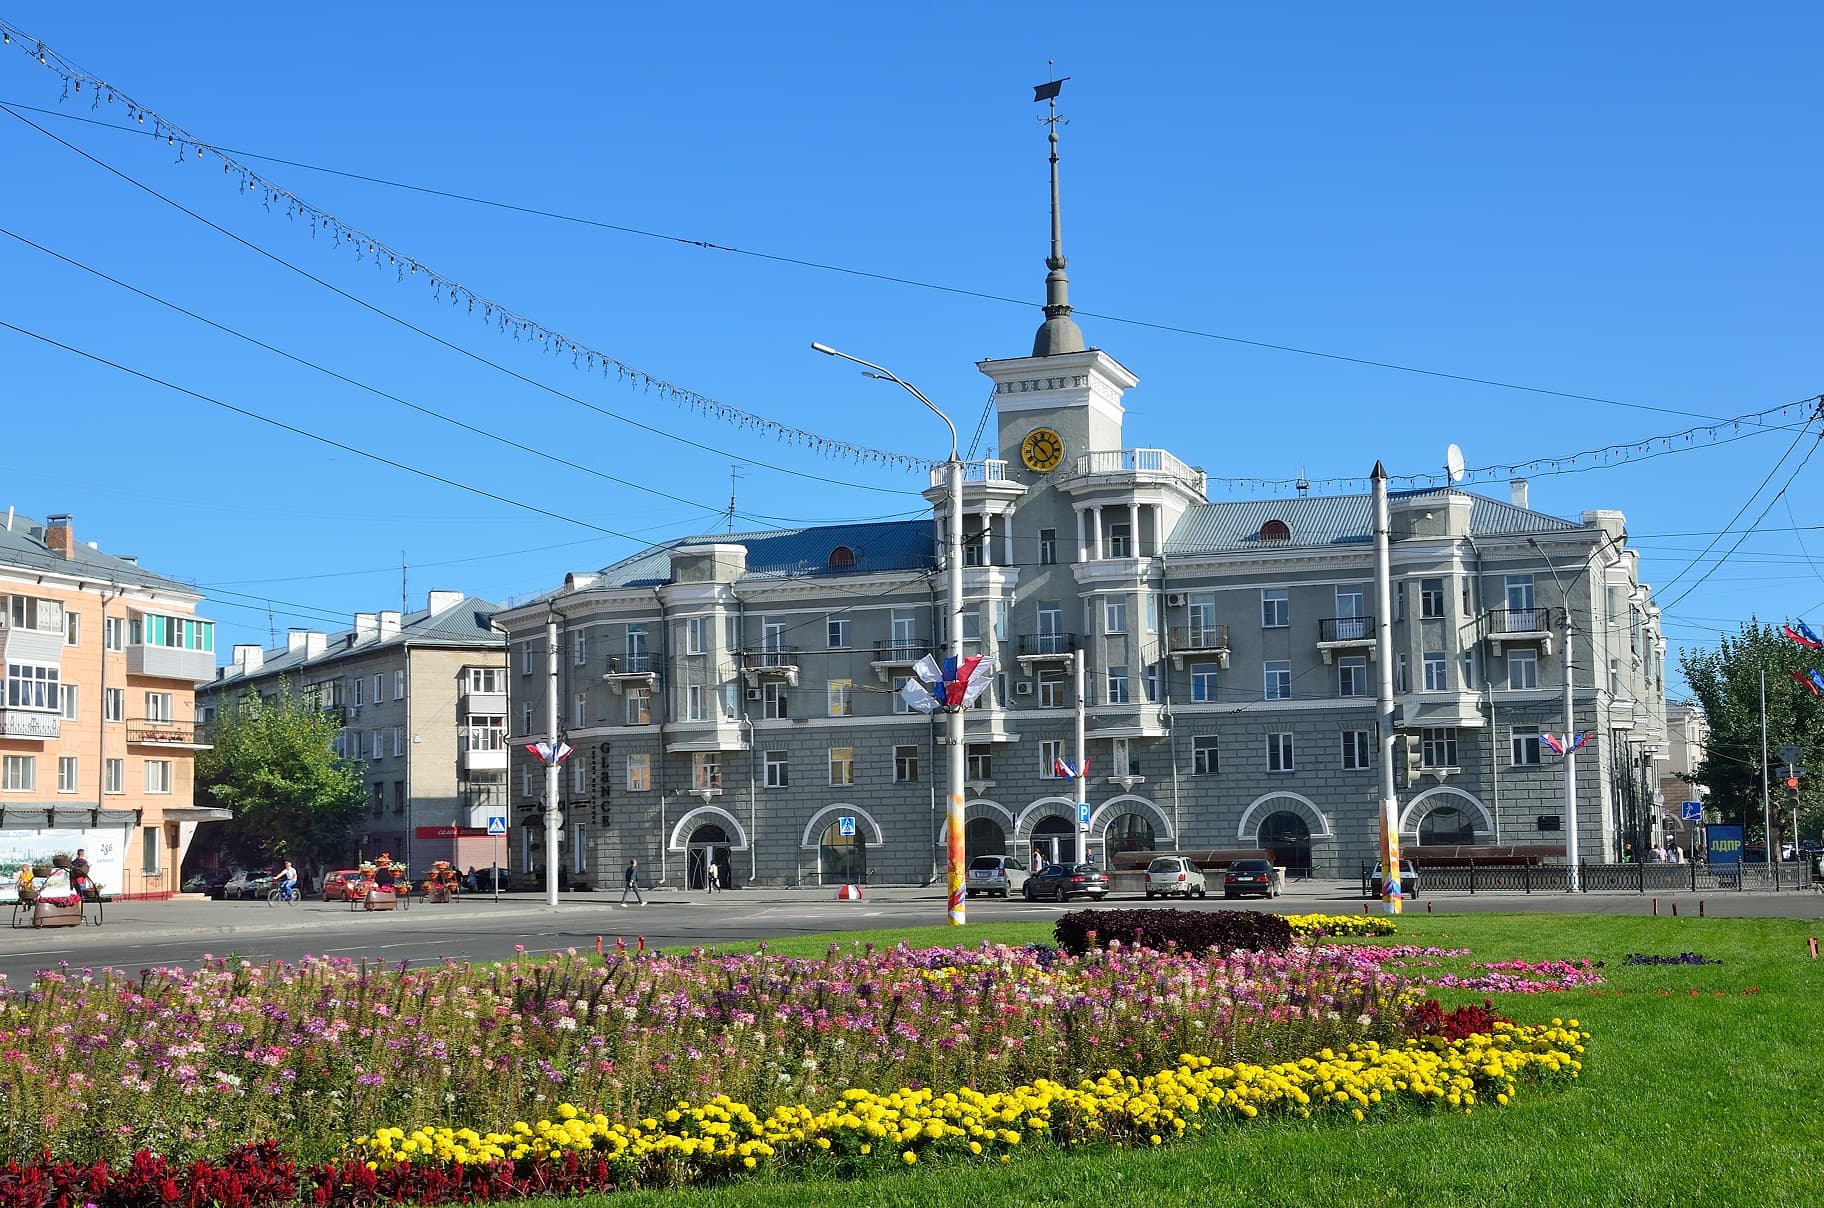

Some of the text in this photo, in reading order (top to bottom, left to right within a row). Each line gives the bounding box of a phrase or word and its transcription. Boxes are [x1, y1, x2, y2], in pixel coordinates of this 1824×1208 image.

[1081, 805, 1088, 820] P
[100, 843, 113, 856] 286
[1710, 840, 1741, 852] ЛДПР
